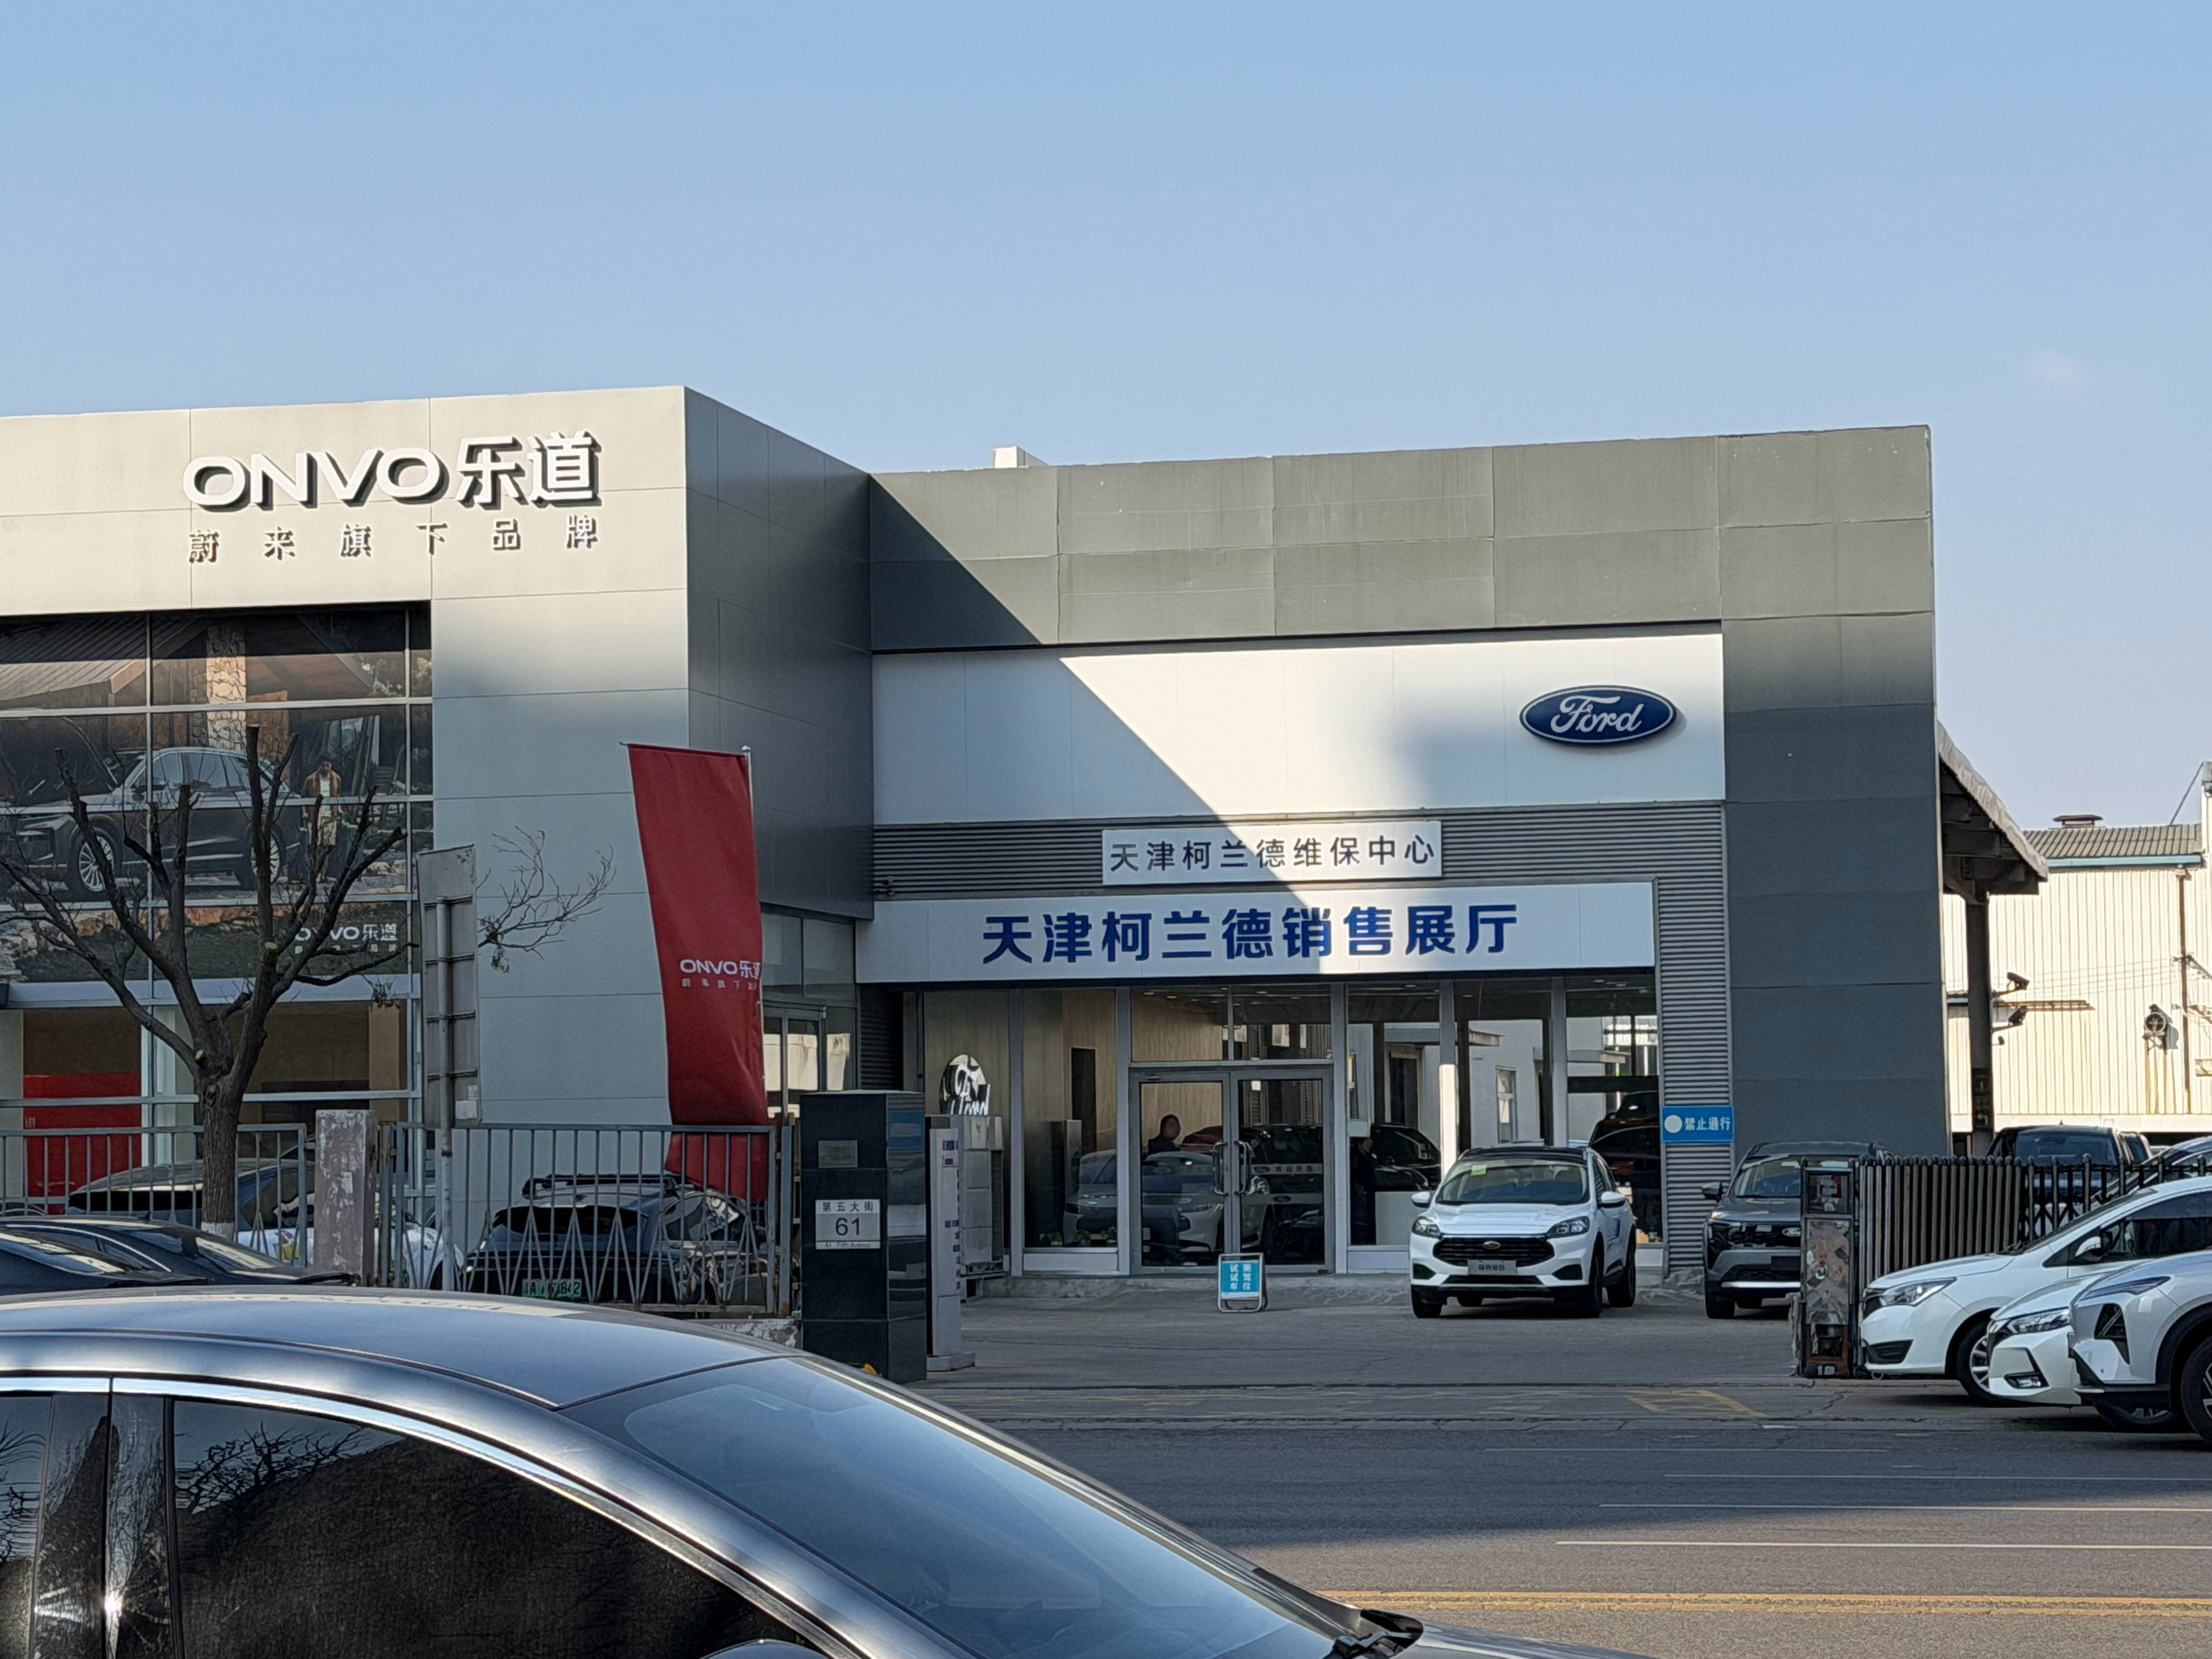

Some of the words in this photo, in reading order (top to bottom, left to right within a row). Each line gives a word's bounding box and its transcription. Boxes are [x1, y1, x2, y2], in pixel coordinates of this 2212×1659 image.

[188, 515, 599, 563] 蔚来旗下品牌
[1550, 695, 1645, 734] Ford
[1109, 834, 1434, 872] 天津柯兰德维保中心
[294, 922, 398, 941] OVO乐道
[982, 904, 1518, 964] 天津柯兰德销售展厅
[1684, 1116, 1731, 1131] 禁止通行
[822, 1201, 874, 1213] 第五大街
[835, 1217, 860, 1236] 61
